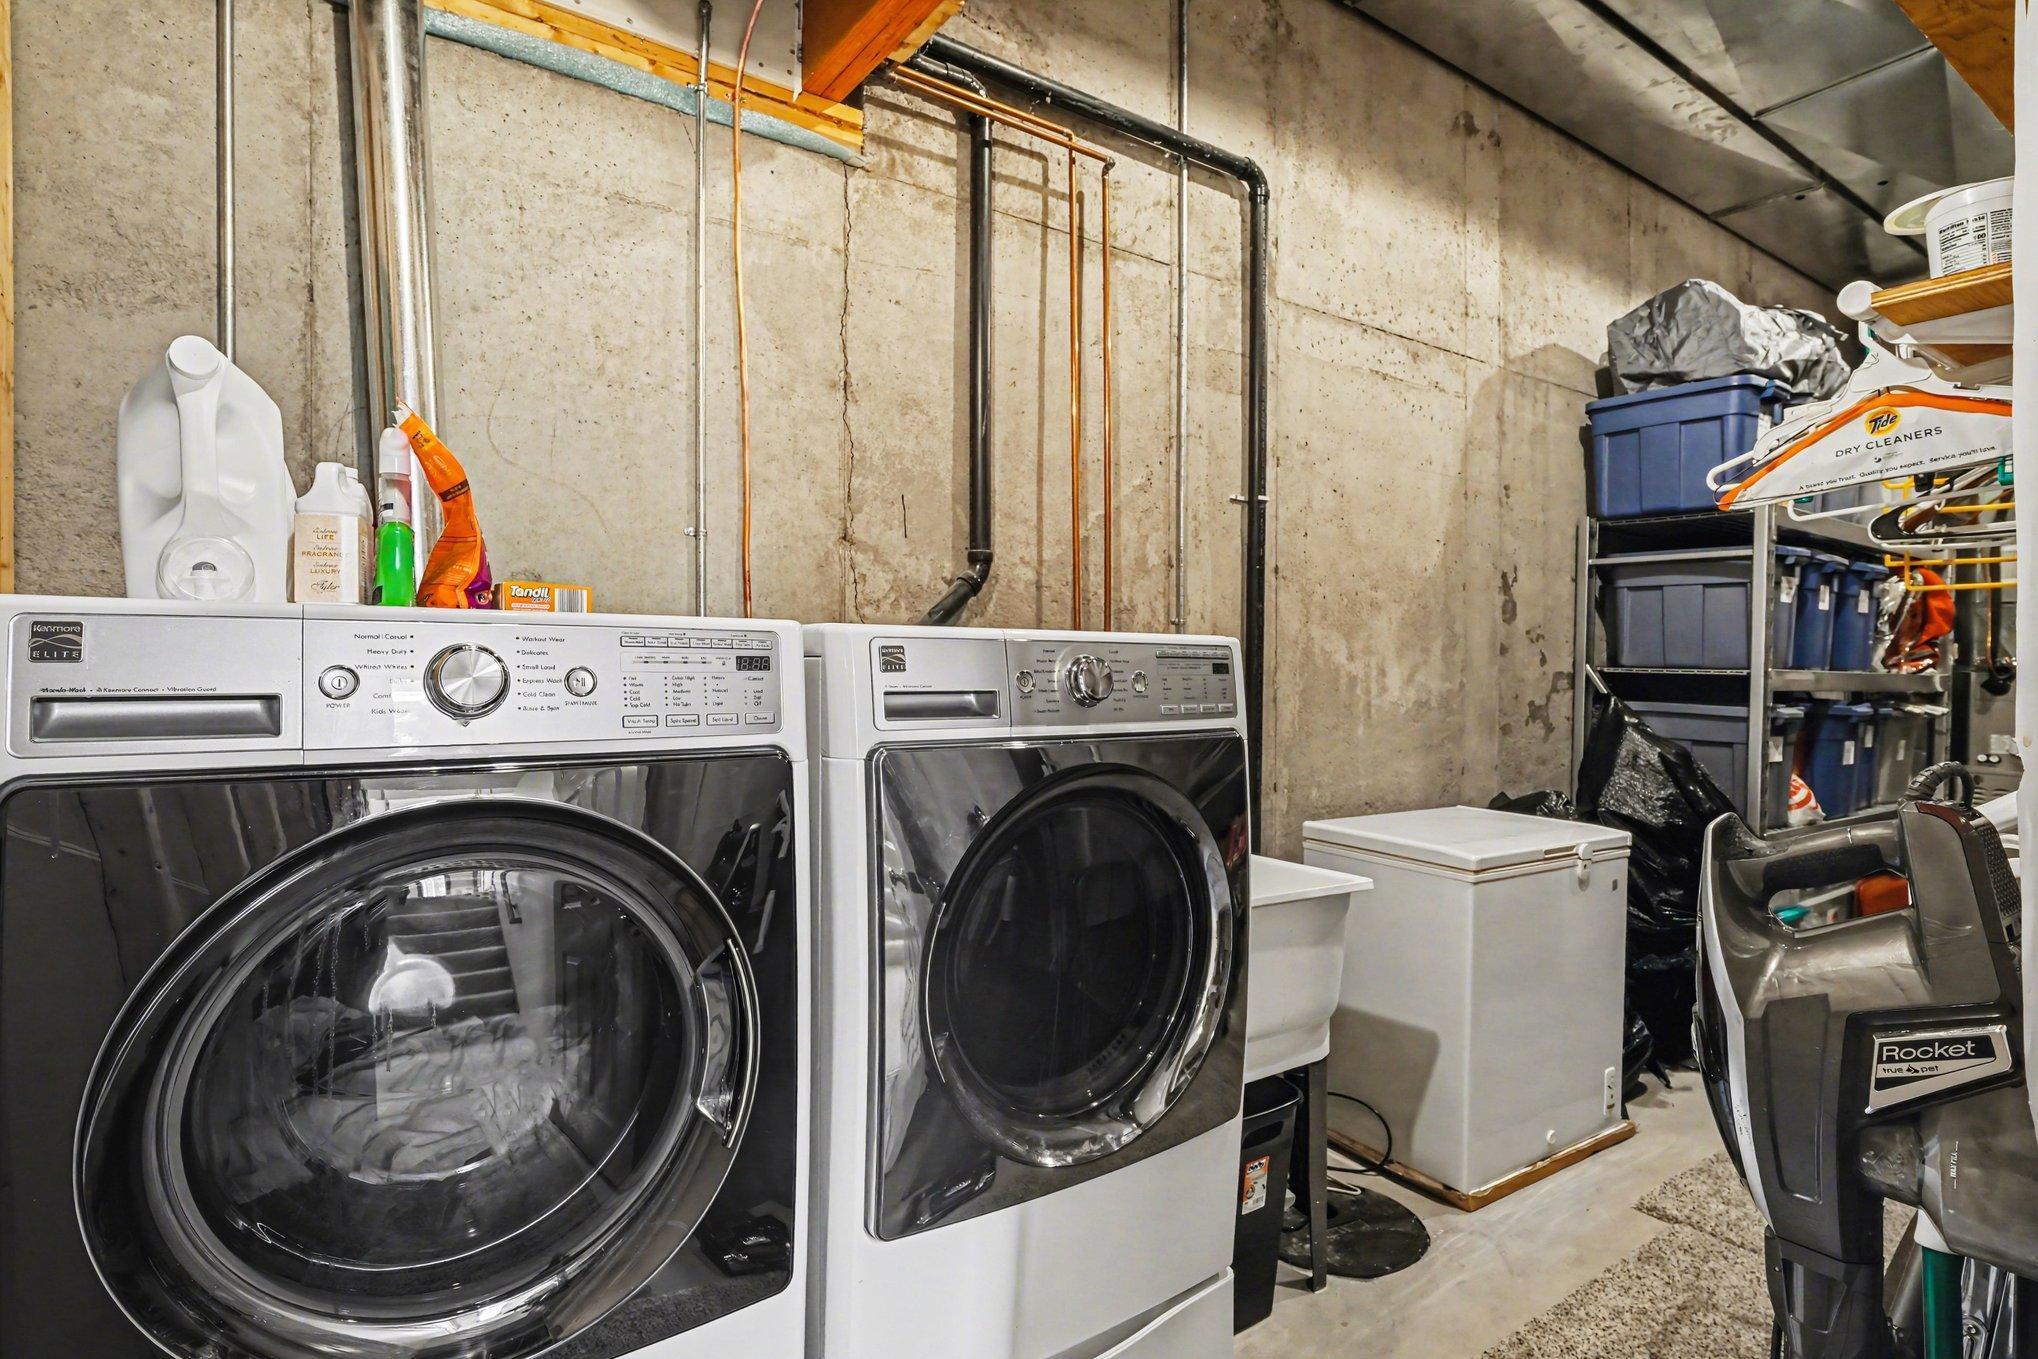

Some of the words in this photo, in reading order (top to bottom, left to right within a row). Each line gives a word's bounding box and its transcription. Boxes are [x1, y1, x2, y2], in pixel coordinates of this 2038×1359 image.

[1869, 414, 1898, 434] Tide
[1835, 445, 1861, 457] DRY
[1865, 426, 1943, 450] CLEANERS
[301, 550, 351, 558] FRAGRAN
[510, 585, 550, 598] Tandil
[33, 624, 81, 633] Kenmore
[32, 650, 80, 658] ELITE
[1881, 1040, 1976, 1062] Rocket
[1920, 1065, 1939, 1074] pet
